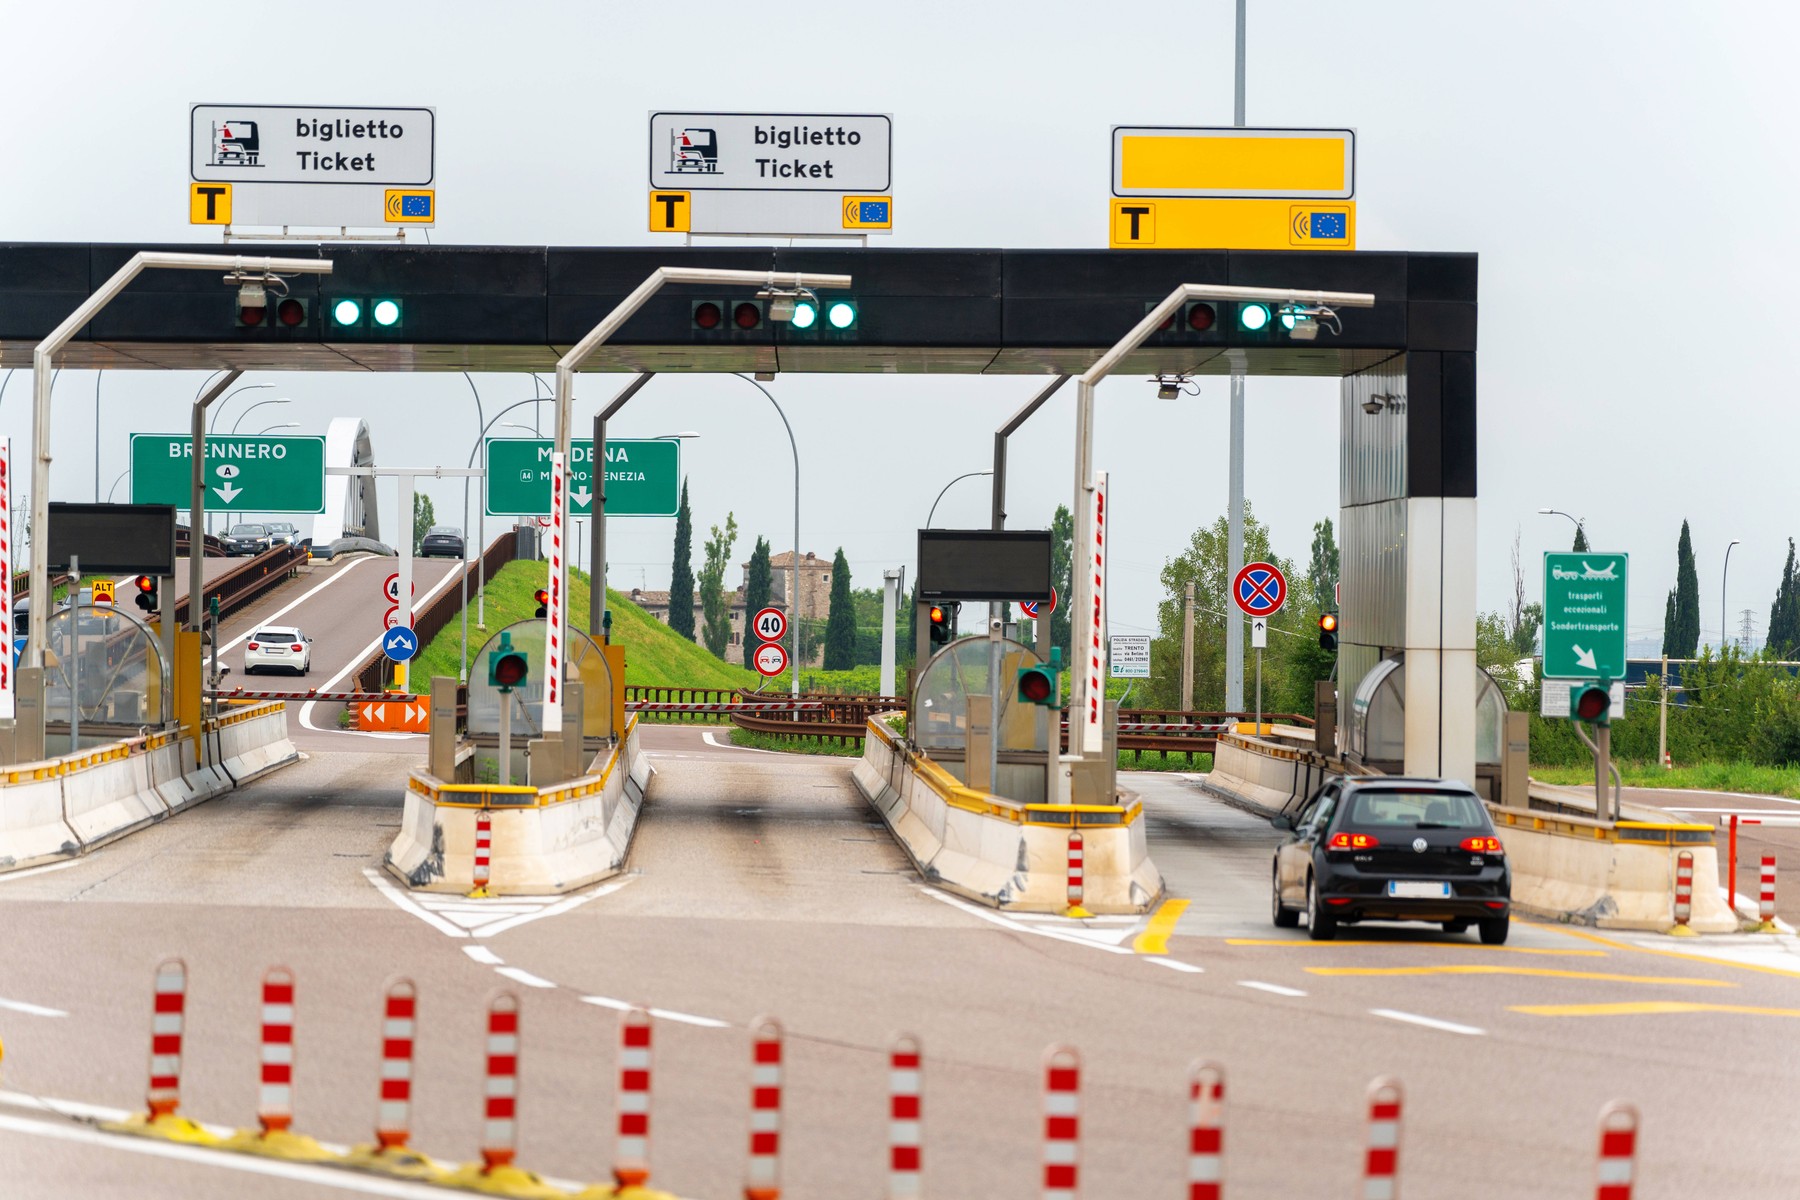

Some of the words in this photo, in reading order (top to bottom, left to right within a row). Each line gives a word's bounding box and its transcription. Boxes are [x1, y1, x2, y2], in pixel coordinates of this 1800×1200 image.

[296, 118, 404, 141] biglietto
[754, 125, 861, 149] biglietto
[296, 151, 375, 171] Ticket
[755, 158, 834, 178] Ticket
[197, 187, 226, 220] T
[656, 195, 685, 228] T
[1121, 207, 1150, 240] T
[537, 447, 629, 463] MDENA
[223, 467, 232, 476] A
[522, 471, 531, 480] A4
[95, 583, 112, 591] ALT
[390, 582, 399, 597] 4
[1567, 591, 1603, 601] trasporti
[761, 617, 780, 632] 40
[1551, 621, 1619, 632] Sondertransporte
